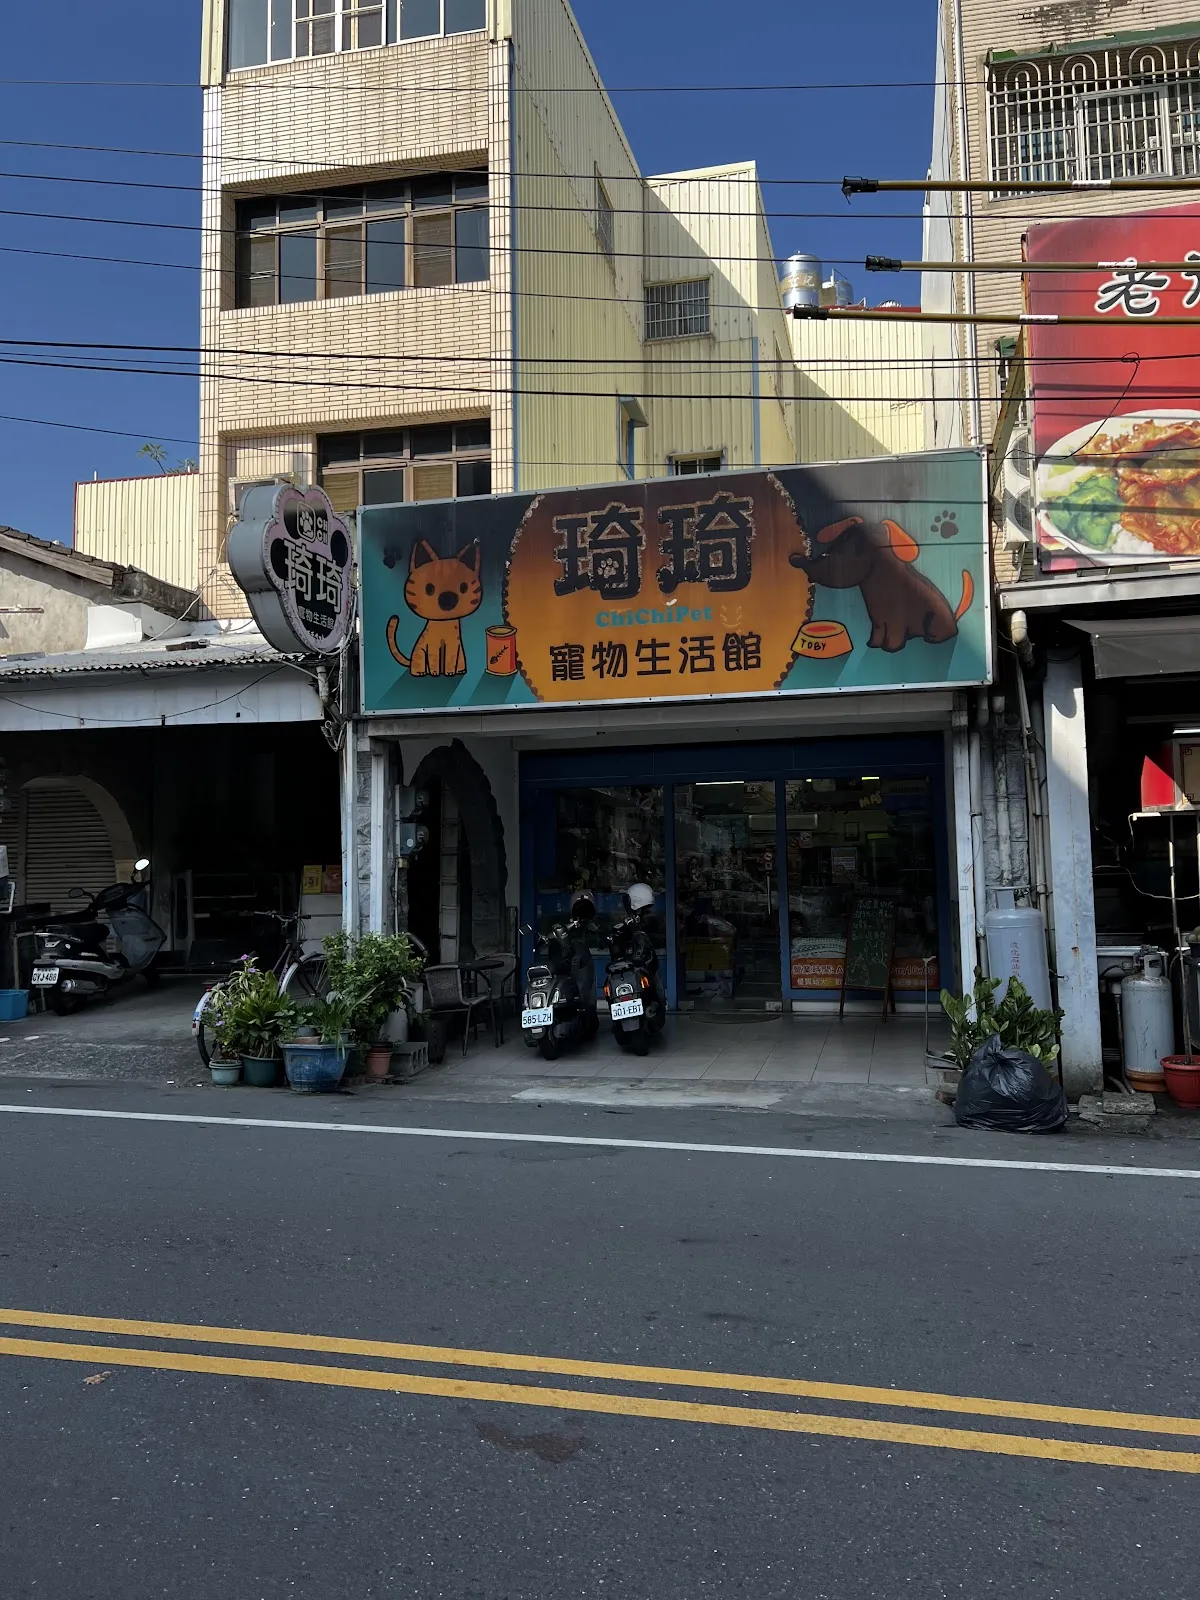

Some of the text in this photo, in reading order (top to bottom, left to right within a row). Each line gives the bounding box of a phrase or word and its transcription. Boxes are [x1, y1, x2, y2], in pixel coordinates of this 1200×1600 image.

[553, 491, 756, 600] 琦琦
[283, 538, 343, 614] 琦琦
[595, 605, 713, 628] ChiChiPet
[549, 631, 762, 682] 寵物生活館
[800, 638, 827, 651] TOBY
